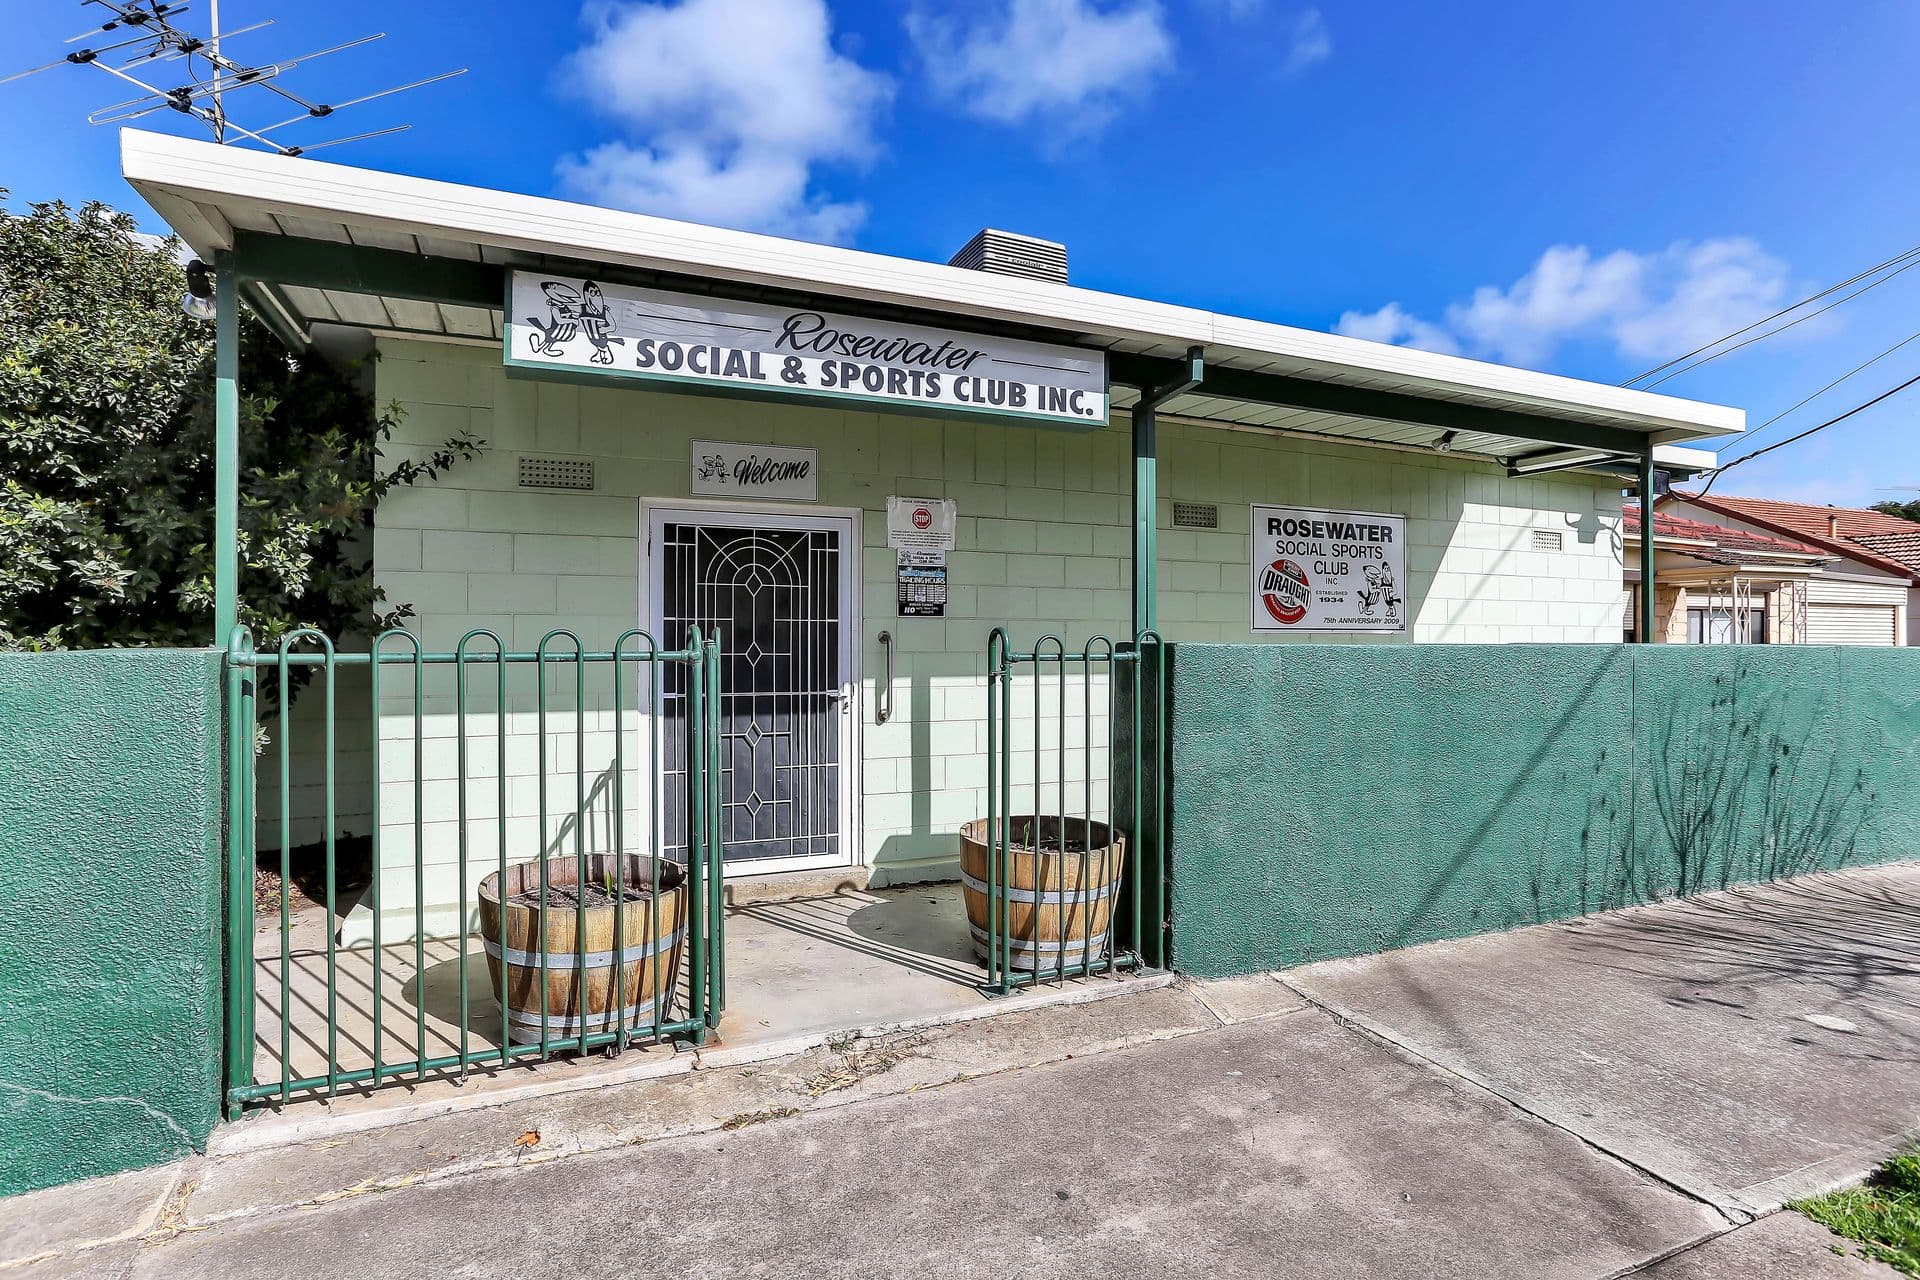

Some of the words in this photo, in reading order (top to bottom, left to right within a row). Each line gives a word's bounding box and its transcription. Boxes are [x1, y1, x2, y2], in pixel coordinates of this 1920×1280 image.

[775, 312, 987, 371] Rosewater
[636, 338, 766, 380] SOCIAL
[780, 355, 807, 385] &
[821, 359, 941, 399] SPORTS
[953, 376, 1027, 408] CLUB
[1038, 385, 1094, 417] INC.
[733, 454, 810, 487] Welcome
[915, 514, 929, 523] STOP
[1267, 517, 1393, 543] ROSEWATER
[1275, 540, 1327, 557] SOCIAL
[1331, 543, 1383, 560] SPORTS
[1313, 560, 1349, 575] CLUB
[899, 576, 925, 584] TRADING
[925, 577, 945, 585] HOURS
[1263, 569, 1311, 608] DRAUGHT
[1323, 616, 1337, 624] 75th
[1338, 617, 1382, 625] ANNIVERSARY
